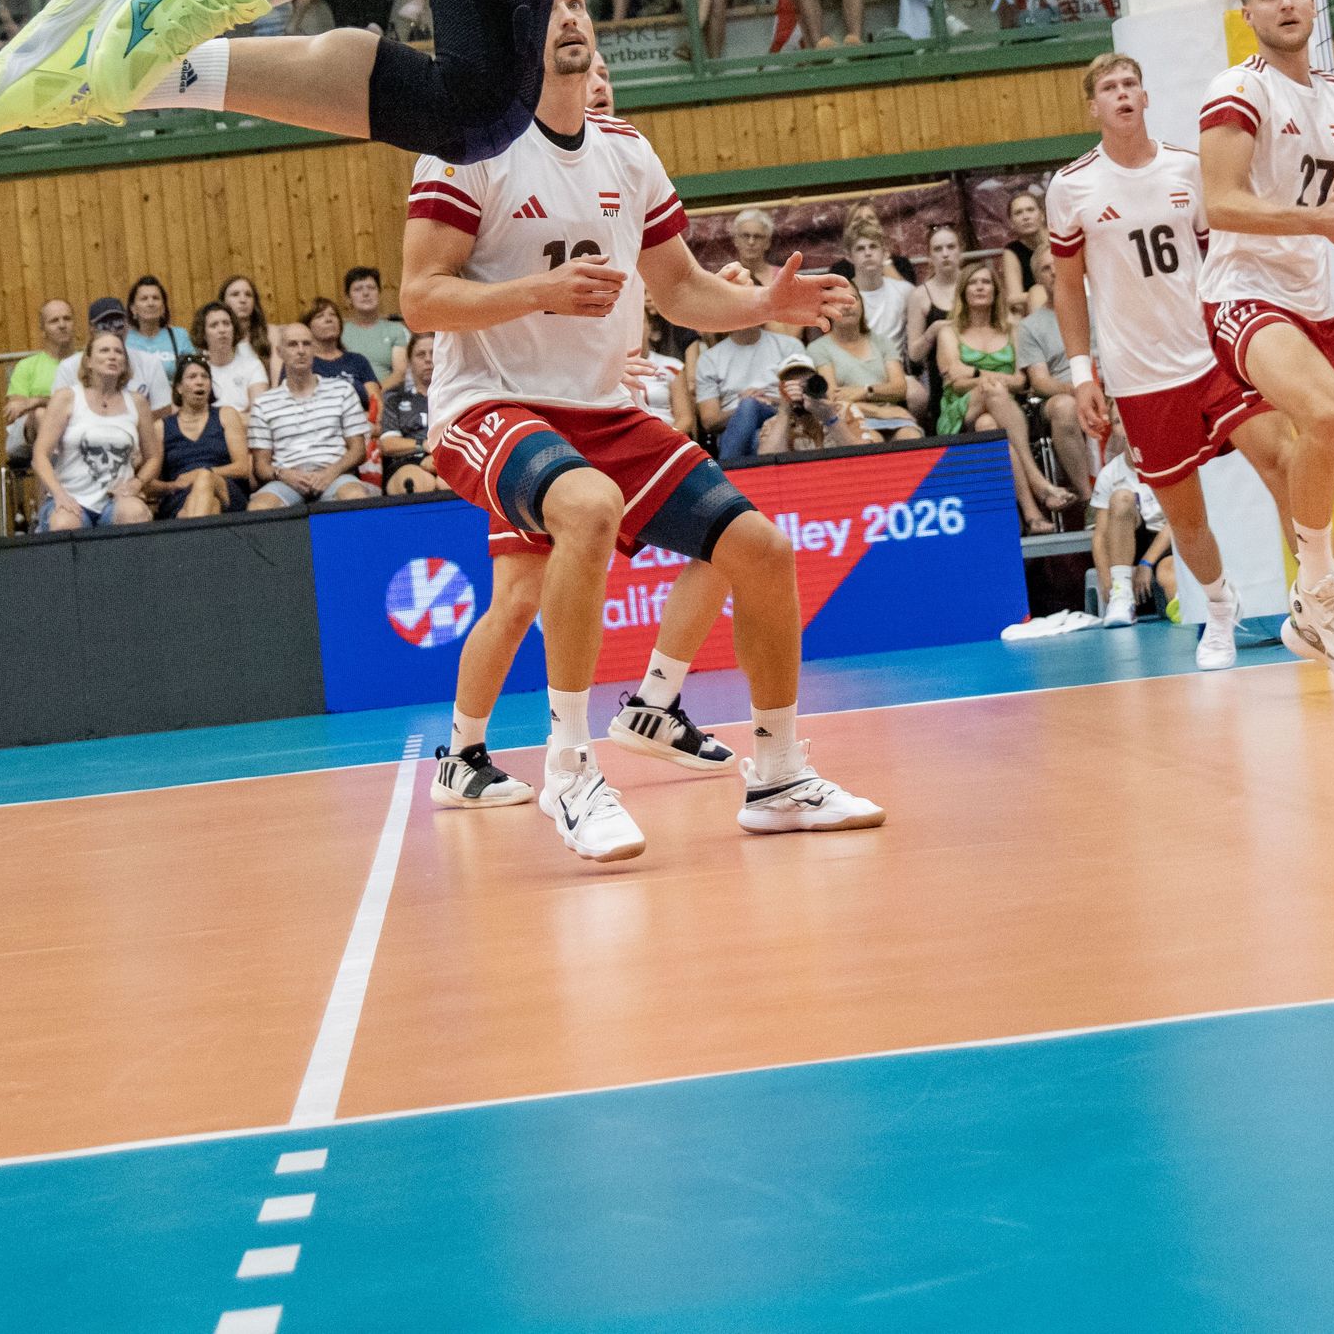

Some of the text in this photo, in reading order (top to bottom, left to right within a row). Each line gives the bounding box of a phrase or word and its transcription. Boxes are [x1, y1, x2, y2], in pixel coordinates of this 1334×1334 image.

[602, 208, 620, 218] AUT
[1128, 224, 1180, 278] 16
[477, 411, 506, 439] 12
[861, 496, 965, 545] 2026
